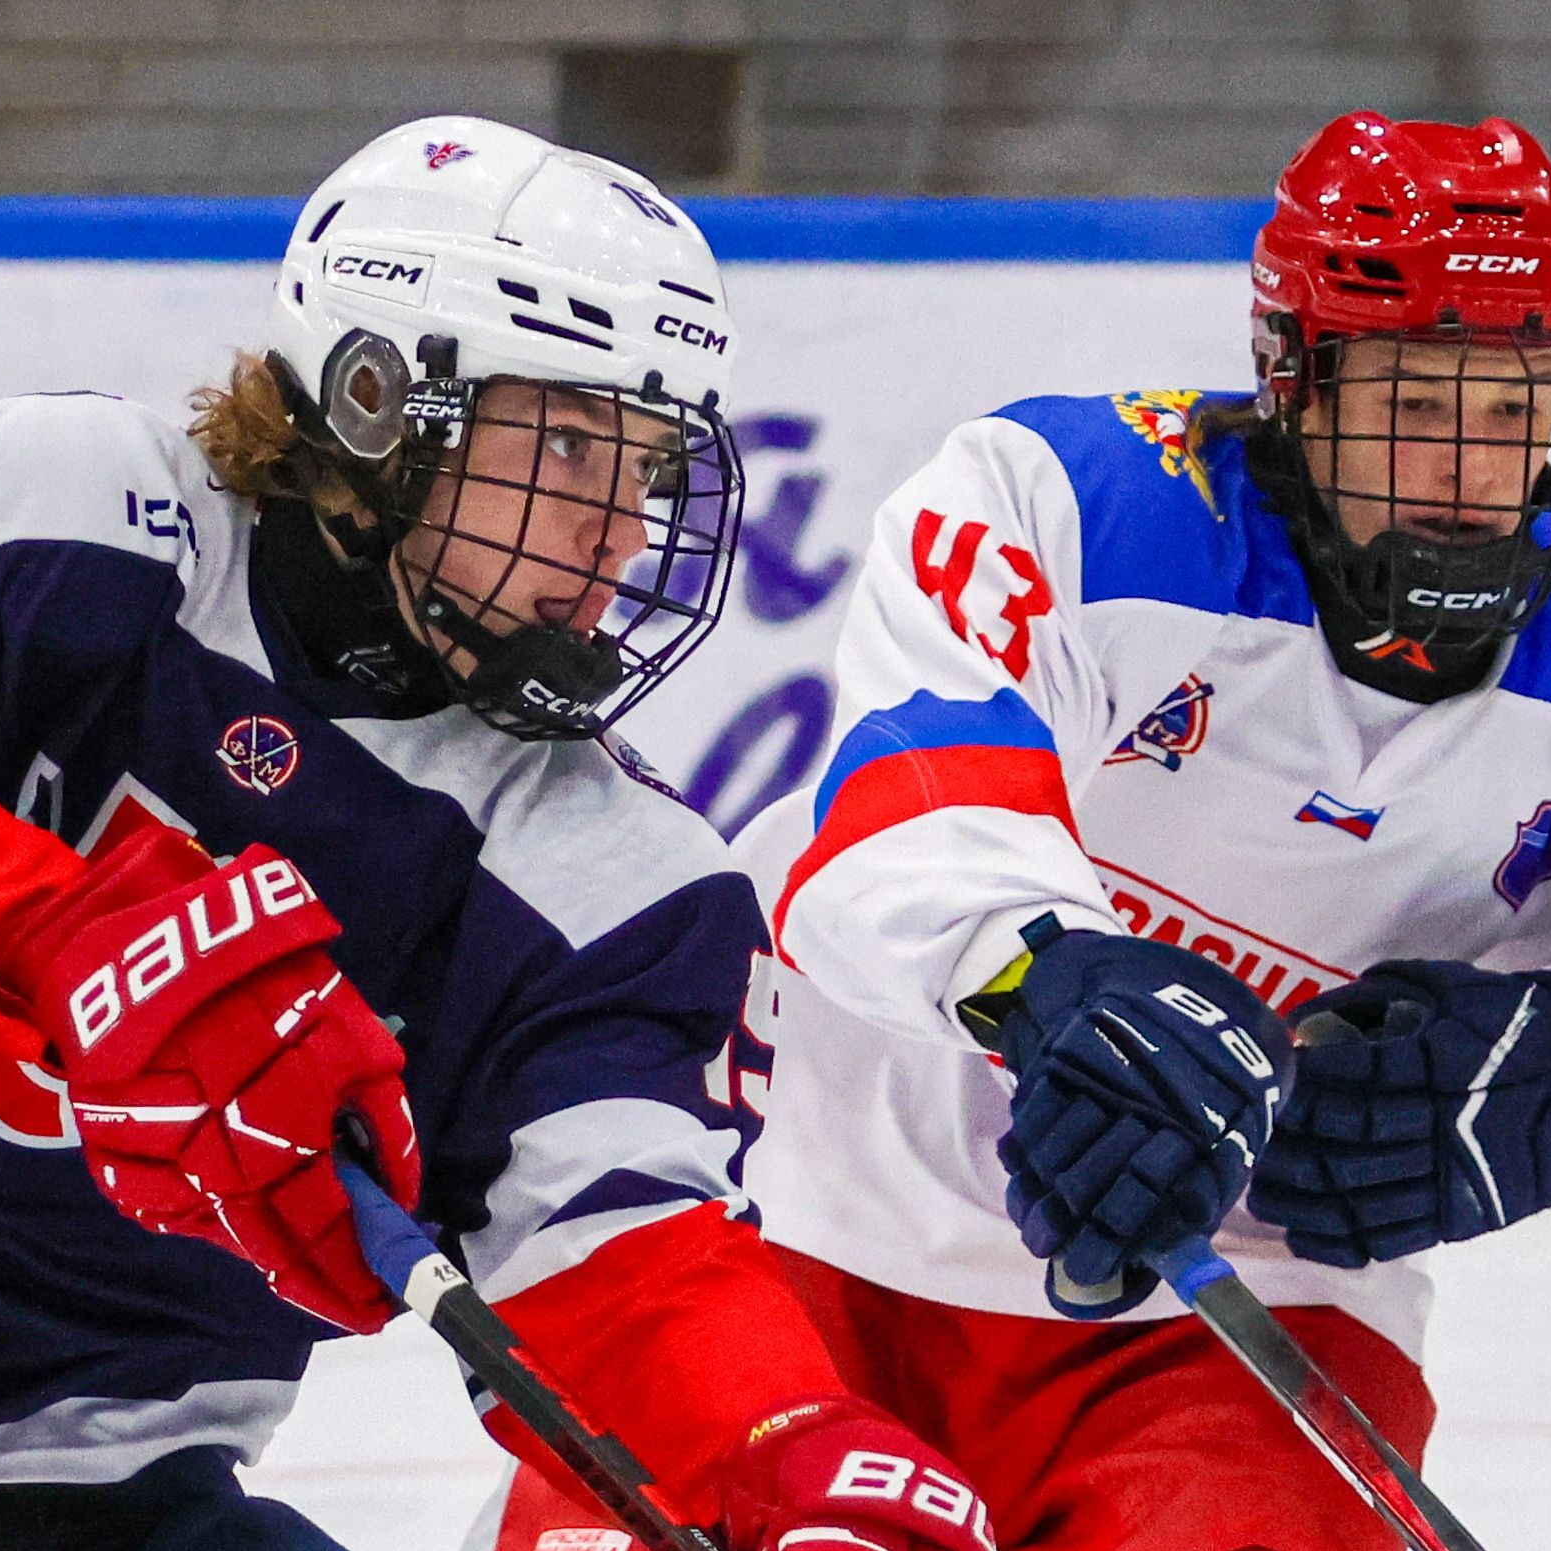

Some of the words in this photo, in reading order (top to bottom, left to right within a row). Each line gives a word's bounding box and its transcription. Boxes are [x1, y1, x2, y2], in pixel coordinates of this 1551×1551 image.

[332, 256, 425, 286] CCM
[1443, 253, 1540, 275] CCM
[654, 314, 730, 354] CCM
[402, 402, 463, 418] CCM
[911, 508, 1055, 681] 43
[1407, 586, 1511, 610] CCM
[521, 678, 601, 718] CCM
